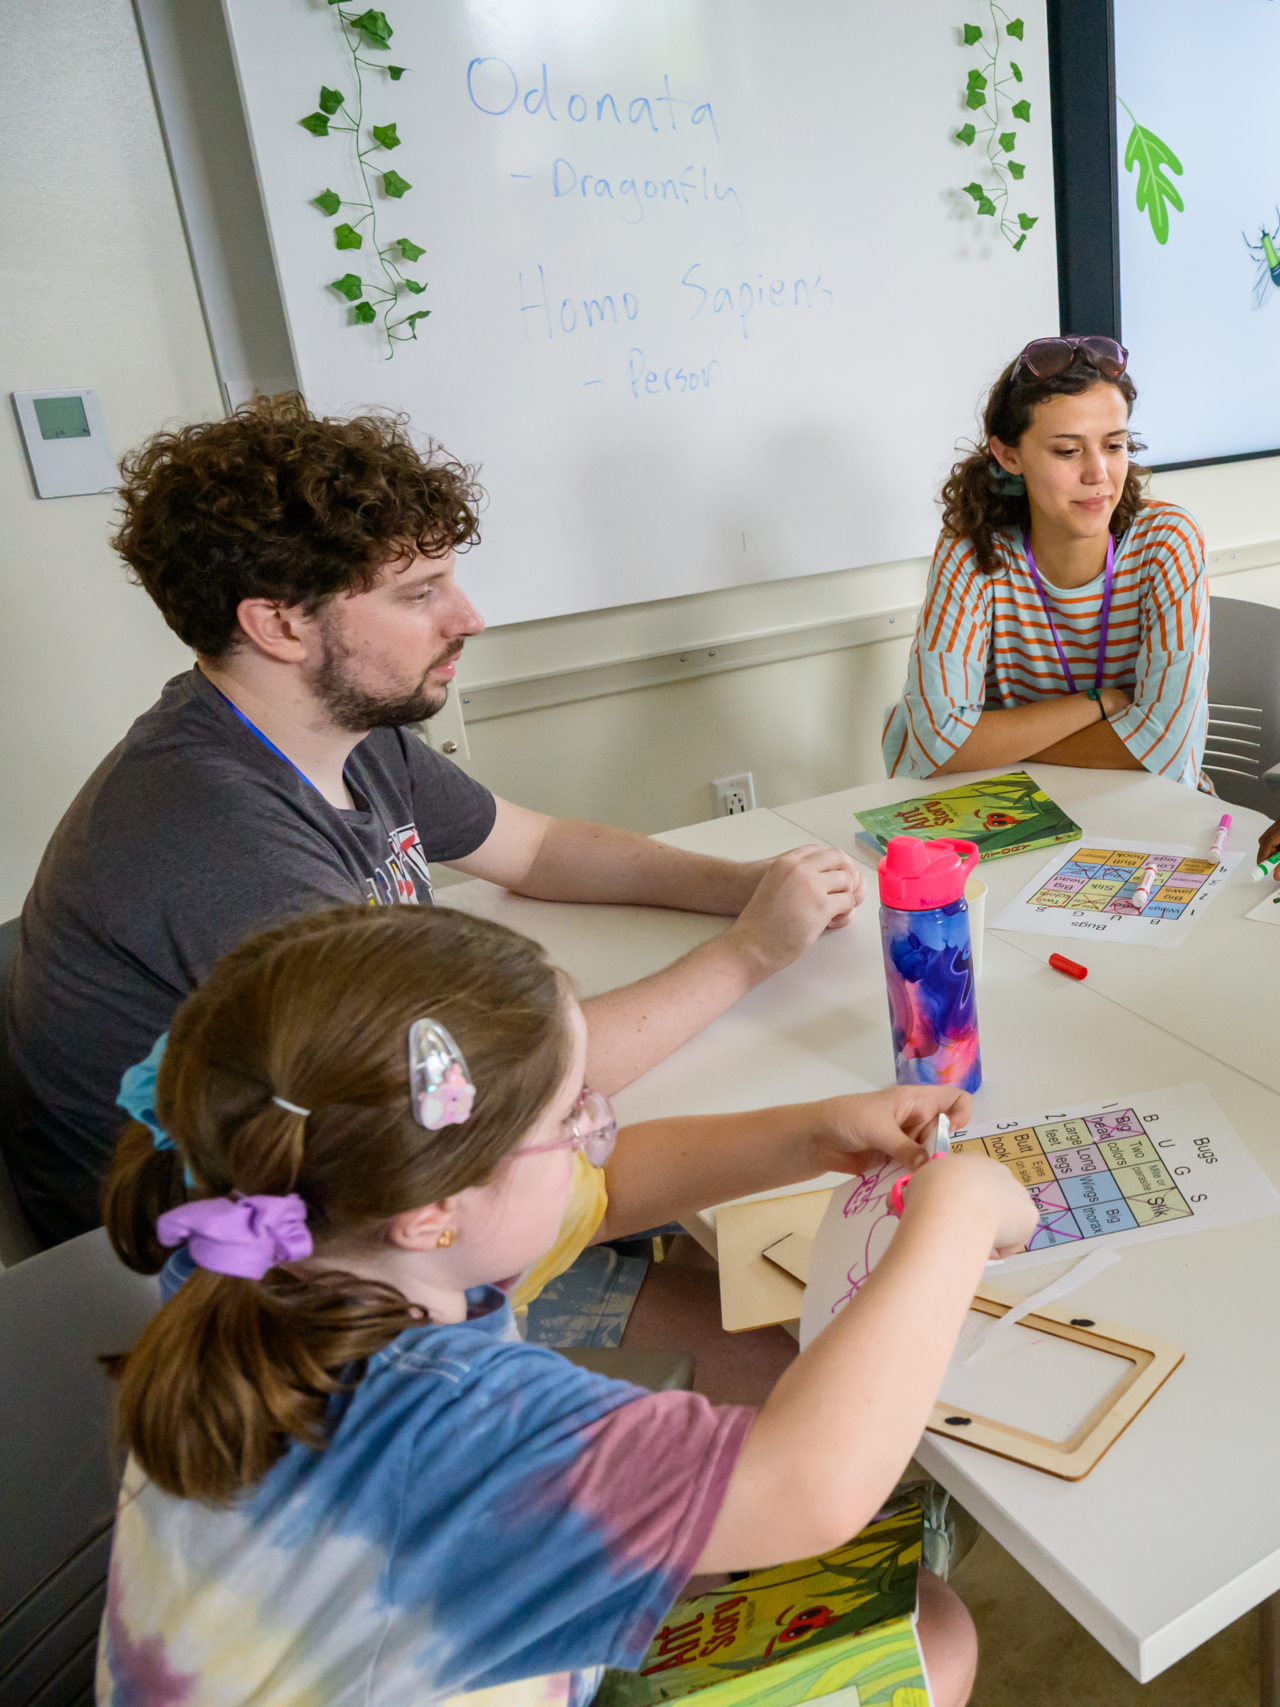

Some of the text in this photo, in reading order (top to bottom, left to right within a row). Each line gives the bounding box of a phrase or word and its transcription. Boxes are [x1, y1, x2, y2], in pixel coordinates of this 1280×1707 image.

[467, 57, 720, 143] Odonata
[552, 158, 747, 246] Dragonfly
[520, 263, 833, 340] Homo Sapiens
[628, 348, 723, 399] Person
[893, 806, 936, 831] Ant
[922, 800, 955, 827] Story
[980, 844, 1031, 859] STORY
[1153, 856, 1177, 864] legs
[1053, 876, 1085, 885] head
[1090, 883, 1115, 891] Slik
[1071, 920, 1107, 931] Bugs
[997, 1121, 1018, 1130] 3
[1063, 1121, 1082, 1145] Large
[1091, 1116, 1115, 1139] head
[1115, 1115, 1131, 1131] Big
[990, 1136, 1011, 1159] hook
[1014, 1133, 1034, 1153] Butt
[1045, 1129, 1062, 1146] feet
[1129, 1140, 1145, 1158] Two
[1077, 1147, 1096, 1171] Long
[1107, 1142, 1127, 1166] colors
[1143, 1114, 1208, 1203] B U G S
[1193, 1137, 1218, 1164] Bugs
[1032, 1160, 1045, 1177] Eyes
[1055, 1153, 1072, 1174] legs
[1019, 1171, 1031, 1183] side
[1131, 1167, 1151, 1191] parasite
[1149, 1164, 1166, 1187] Mite or
[1080, 1175, 1099, 1202] Wings
[1082, 1207, 1103, 1234] thorax
[1106, 1208, 1121, 1224] Big
[699, 1595, 748, 1658] Story
[640, 1612, 705, 1677] Ant
